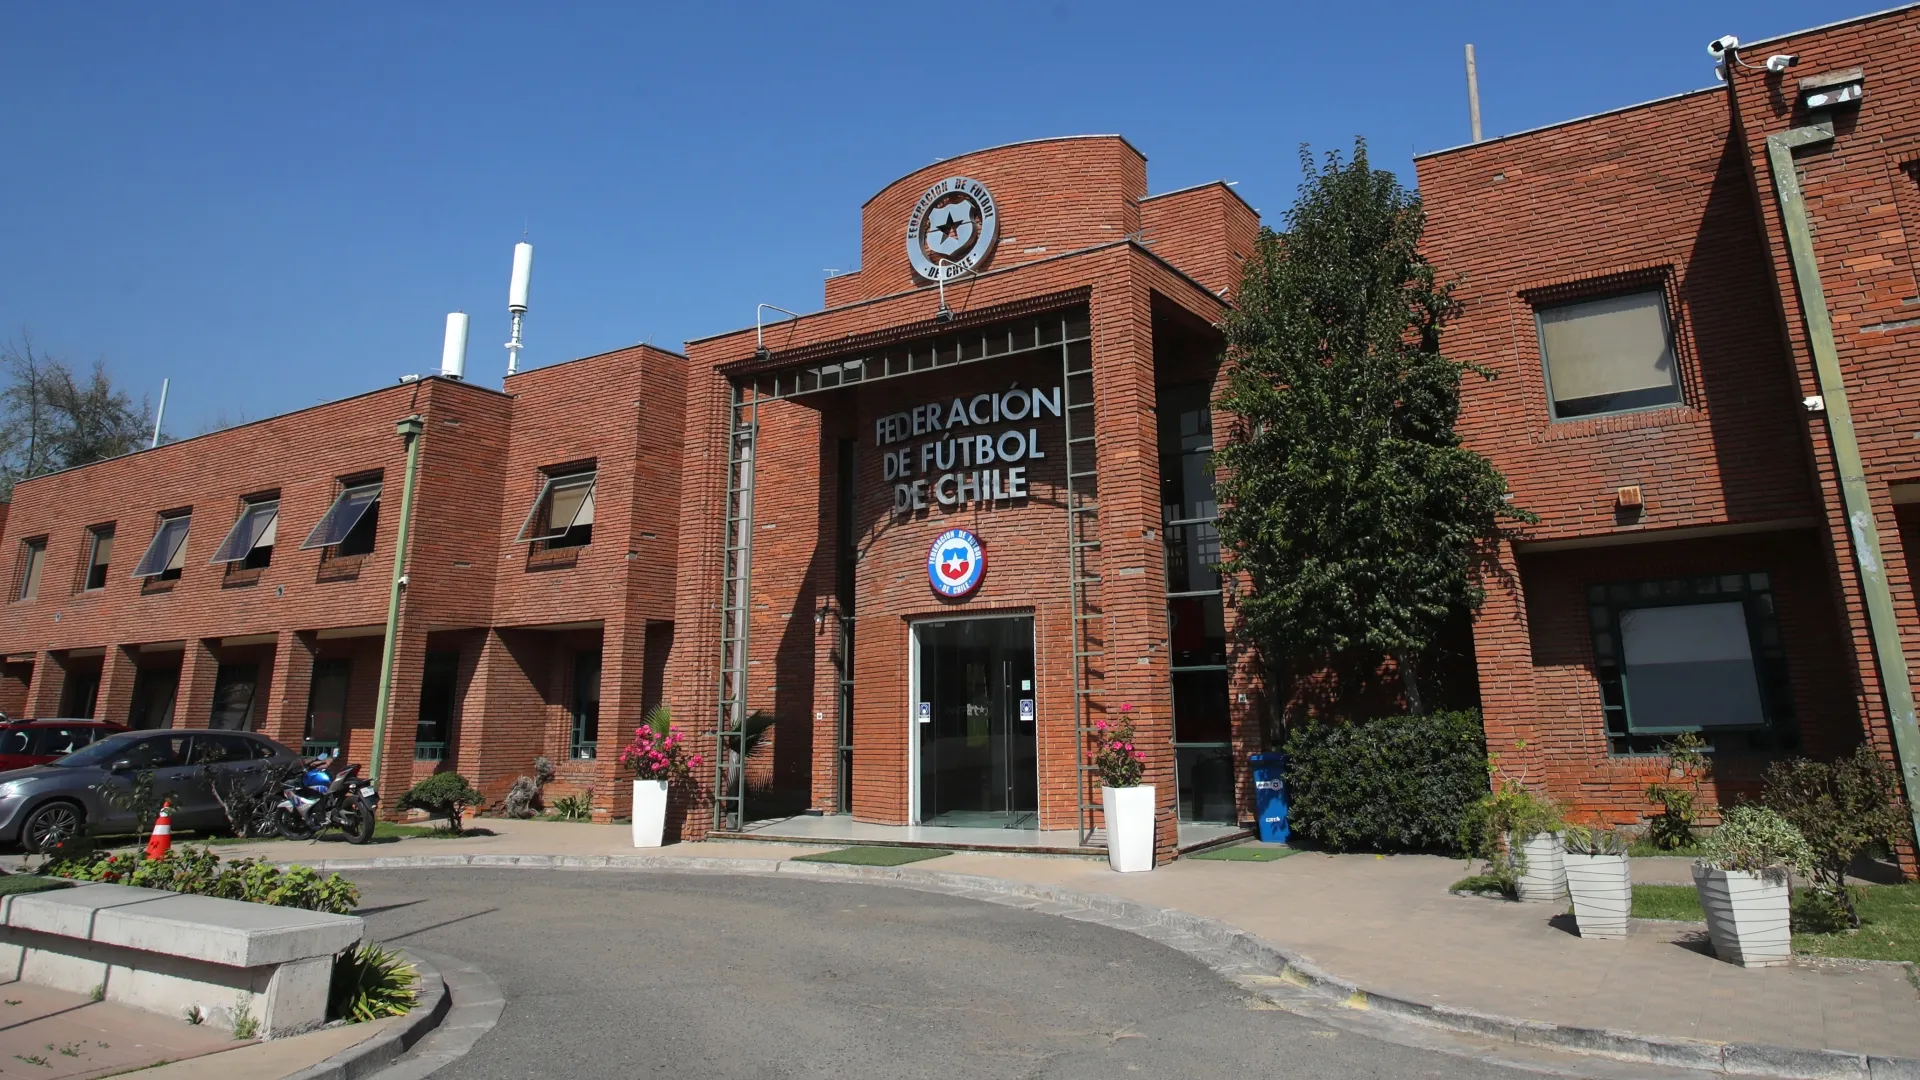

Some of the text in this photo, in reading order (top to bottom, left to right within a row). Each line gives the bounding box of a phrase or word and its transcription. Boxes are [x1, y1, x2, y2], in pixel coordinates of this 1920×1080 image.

[955, 178, 968, 190] DE
[928, 257, 973, 279] DE CHILE
[876, 381, 1061, 446] FEDERACIÓN
[883, 429, 1045, 482] DE FÚTBOL
[894, 466, 1027, 514] DE CHILE
[958, 530, 967, 539] DE
[941, 581, 971, 594] DE CHILE
